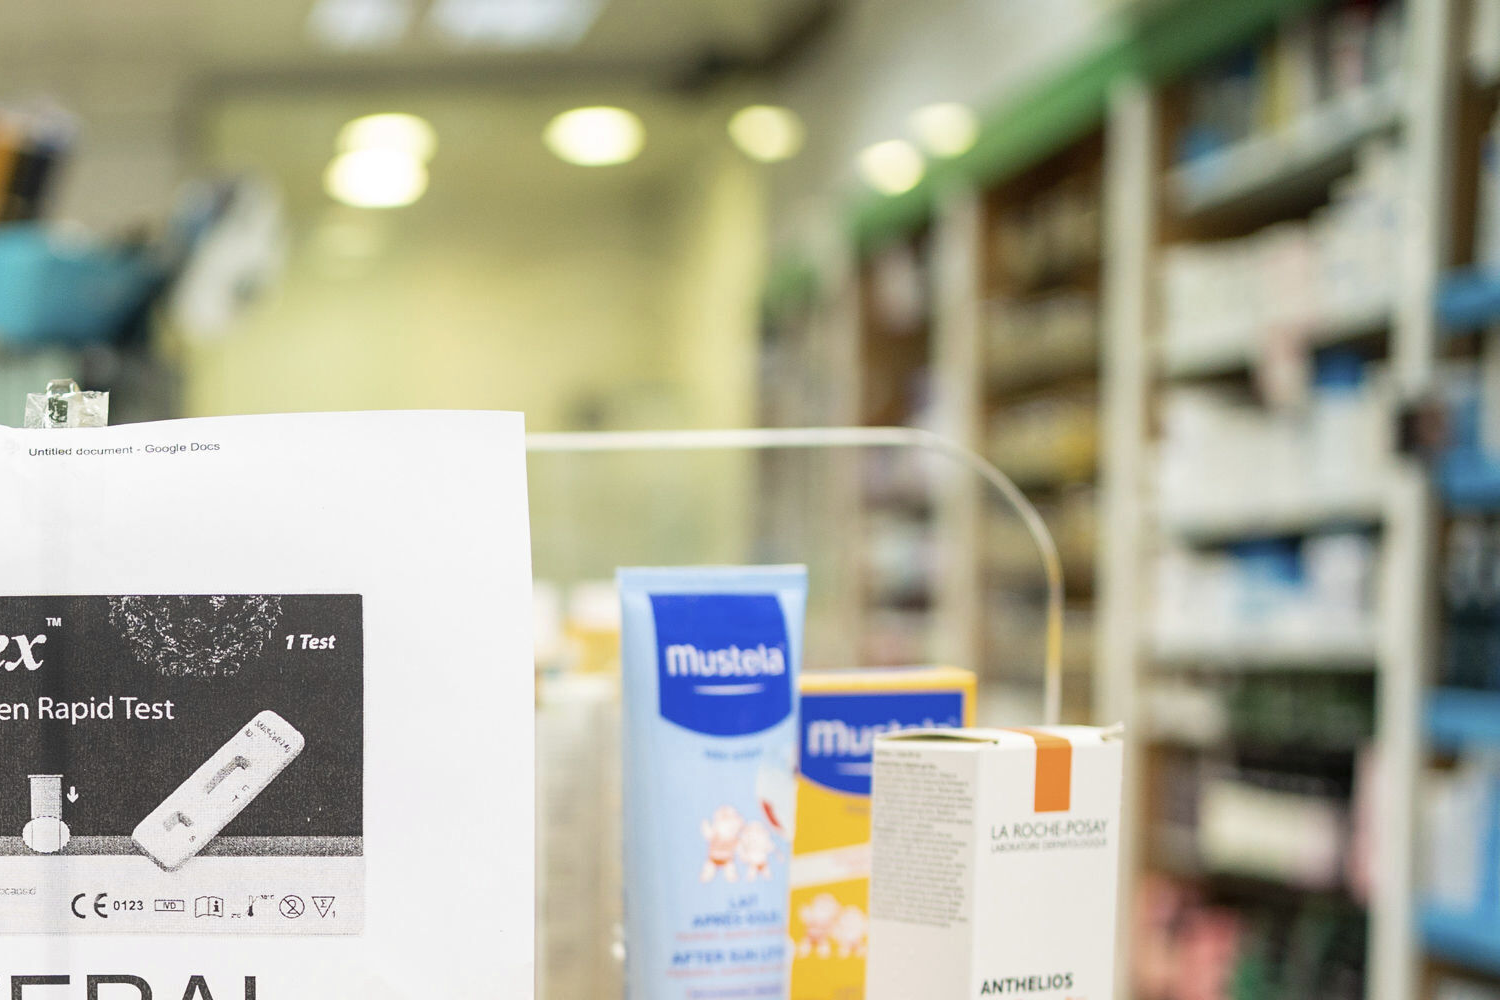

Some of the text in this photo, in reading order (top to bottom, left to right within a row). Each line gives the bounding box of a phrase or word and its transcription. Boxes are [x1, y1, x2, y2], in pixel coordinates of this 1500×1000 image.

[28, 447, 72, 457] Untitled
[76, 446, 133, 456] document
[145, 443, 187, 455] Google
[190, 441, 220, 452] Docs
[285, 634, 336, 650] 1 Test
[665, 643, 786, 677] Mustela
[38, 697, 114, 725] Rapid
[118, 697, 175, 720] Test
[991, 823, 1009, 841] LA
[113, 899, 144, 911] 0123
[980, 973, 1074, 995] ANTHELIOS
